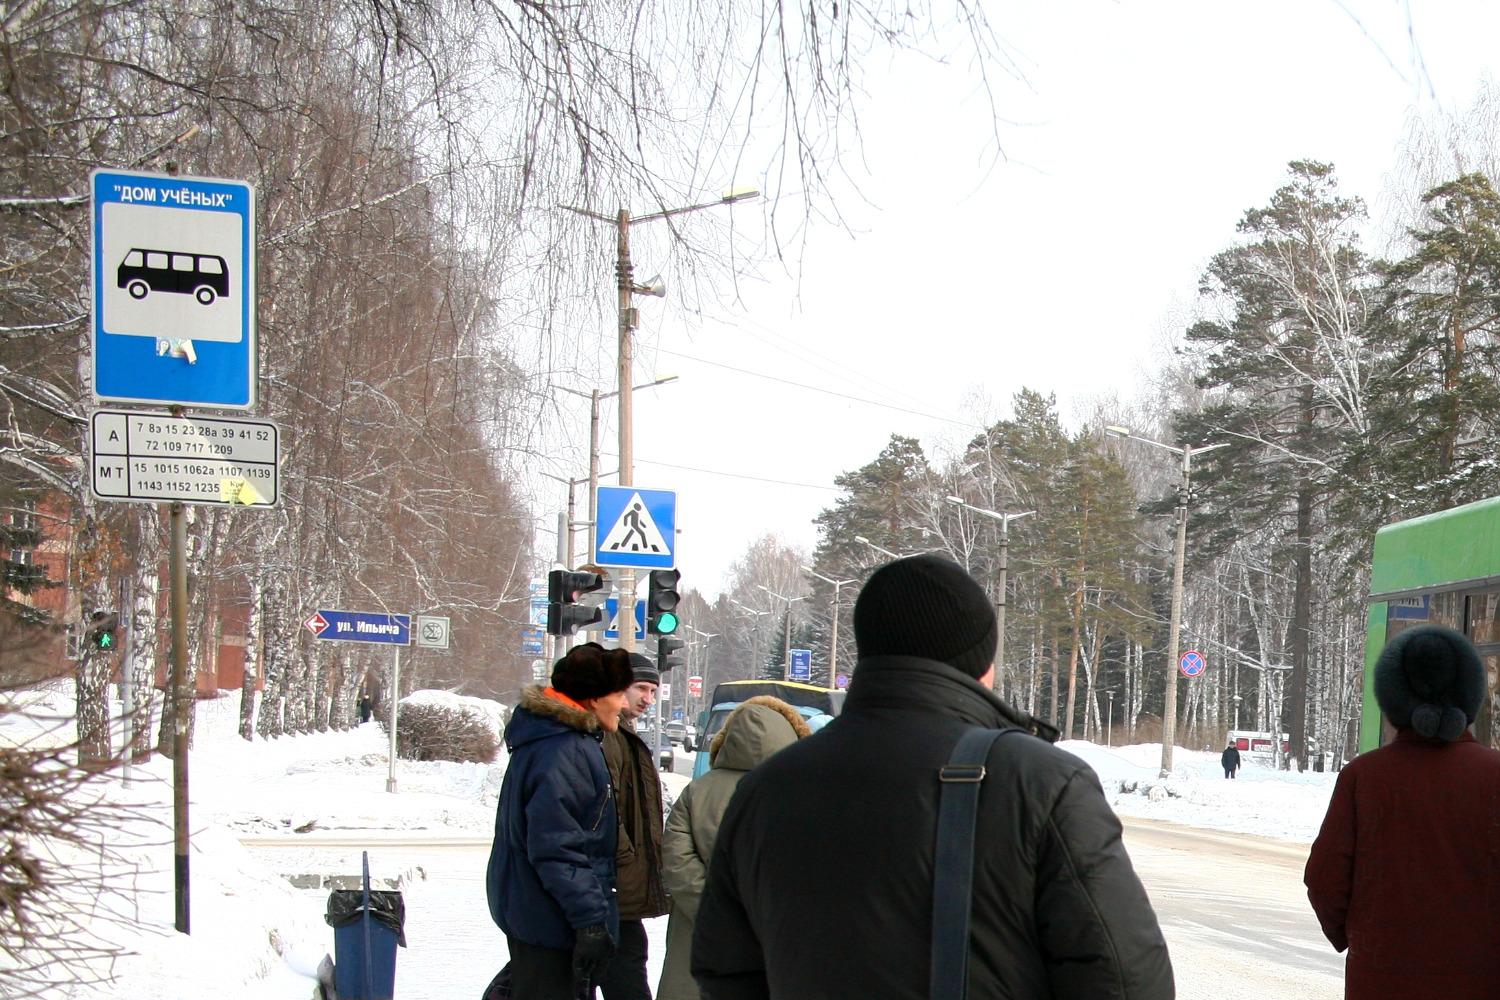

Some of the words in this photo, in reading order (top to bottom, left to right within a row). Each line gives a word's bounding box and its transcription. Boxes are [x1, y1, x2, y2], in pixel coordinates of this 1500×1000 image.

[113, 185, 157, 203] "ДОМ
[137, 423, 143, 433] 7
[165, 424, 178, 434] 15
[182, 425, 195, 435] 23
[198, 426, 217, 437] 28а
[222, 428, 234, 438] 39
[239, 430, 251, 439] 41
[256, 431, 269, 441] 52
[146, 440, 159, 451] 72
[163, 441, 182, 452] 109
[185, 442, 204, 453] 717
[208, 444, 233, 455] 1209
[134, 463, 147, 473] 15
[154, 463, 180, 474] 1015
[219, 466, 242, 476] 1107
[246, 468, 271, 478] 1139
[137, 480, 162, 491] 1143
[166, 481, 191, 492] 1152
[194, 483, 220, 493] 1235
[337, 621, 354, 633] ул.
[356, 620, 400, 635] Ильича
